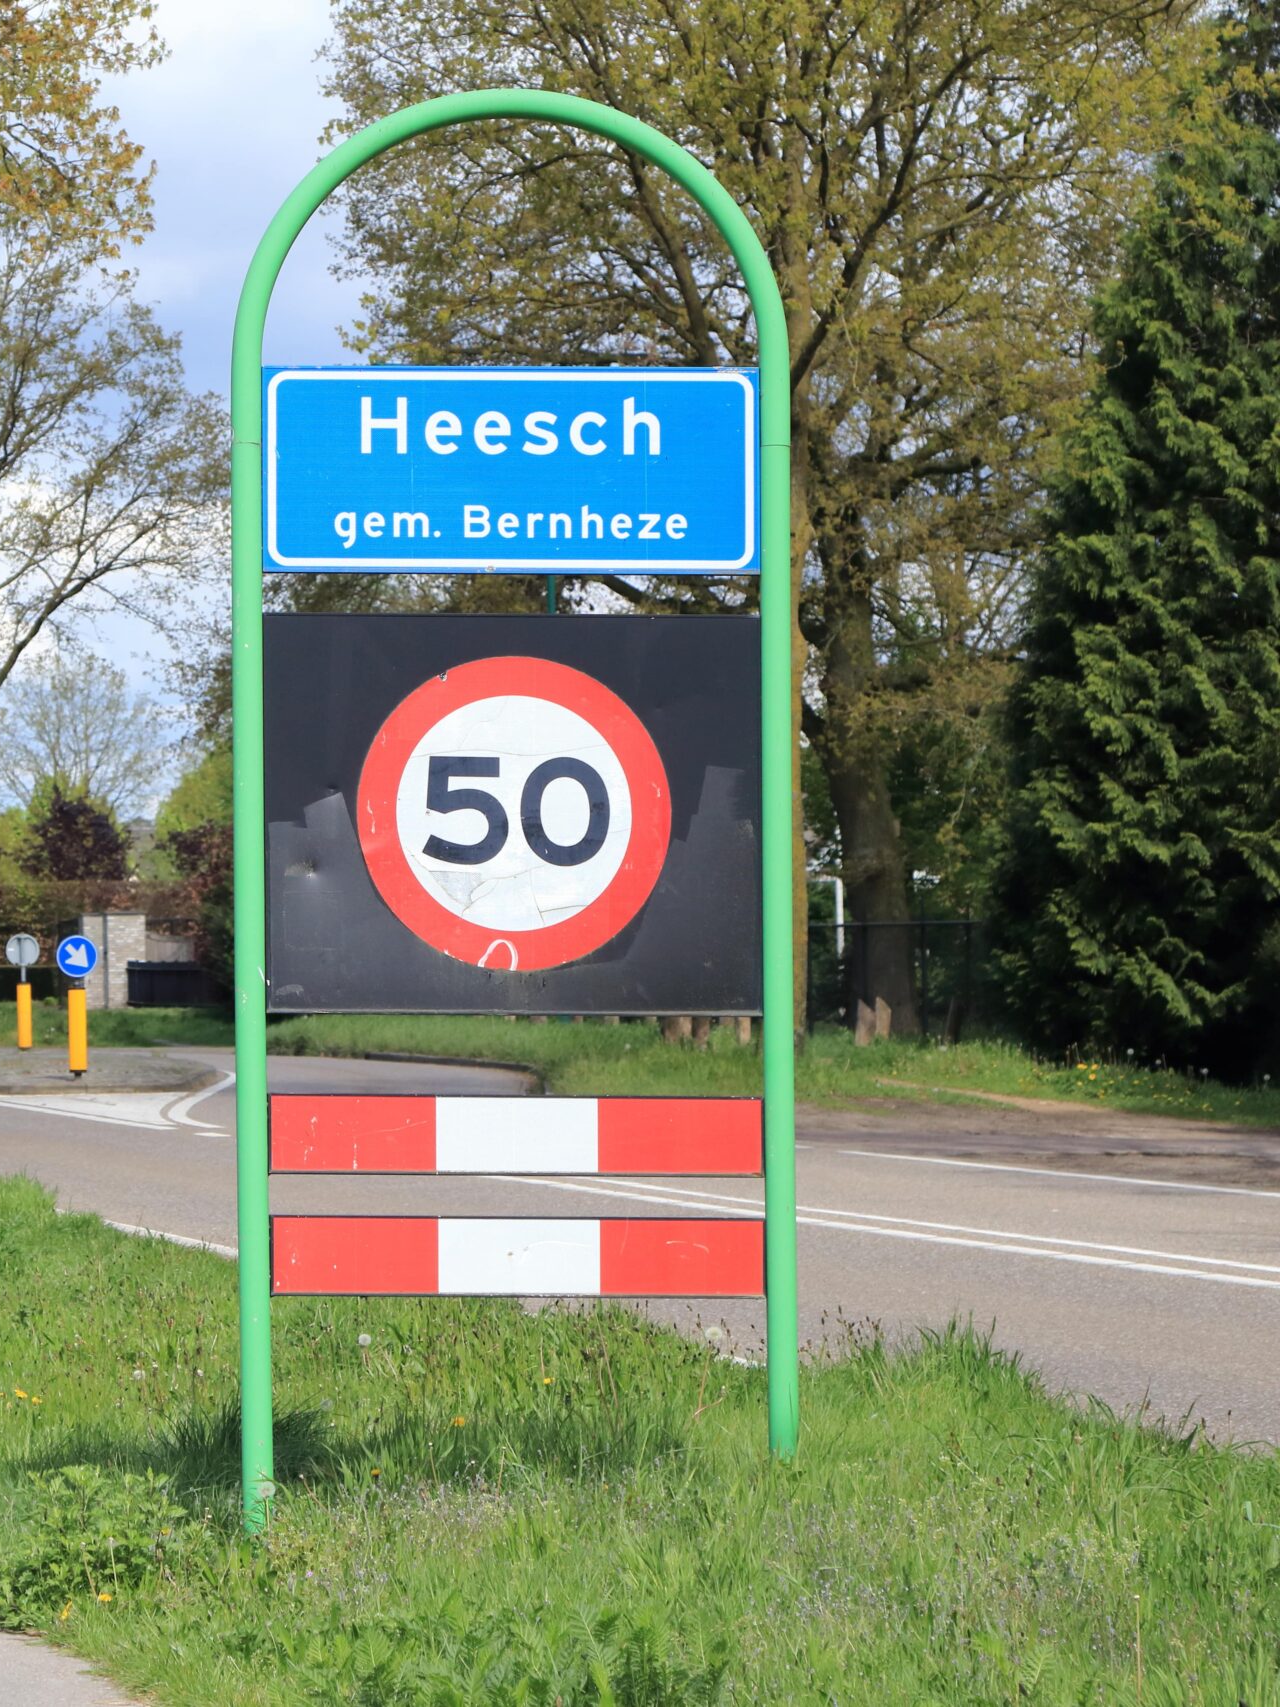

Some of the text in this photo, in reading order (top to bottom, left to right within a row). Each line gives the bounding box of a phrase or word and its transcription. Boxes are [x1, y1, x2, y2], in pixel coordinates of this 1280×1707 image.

[360, 396, 662, 456] Heesch
[334, 504, 689, 549] gem. Bernheze
[422, 756, 610, 867] 50
